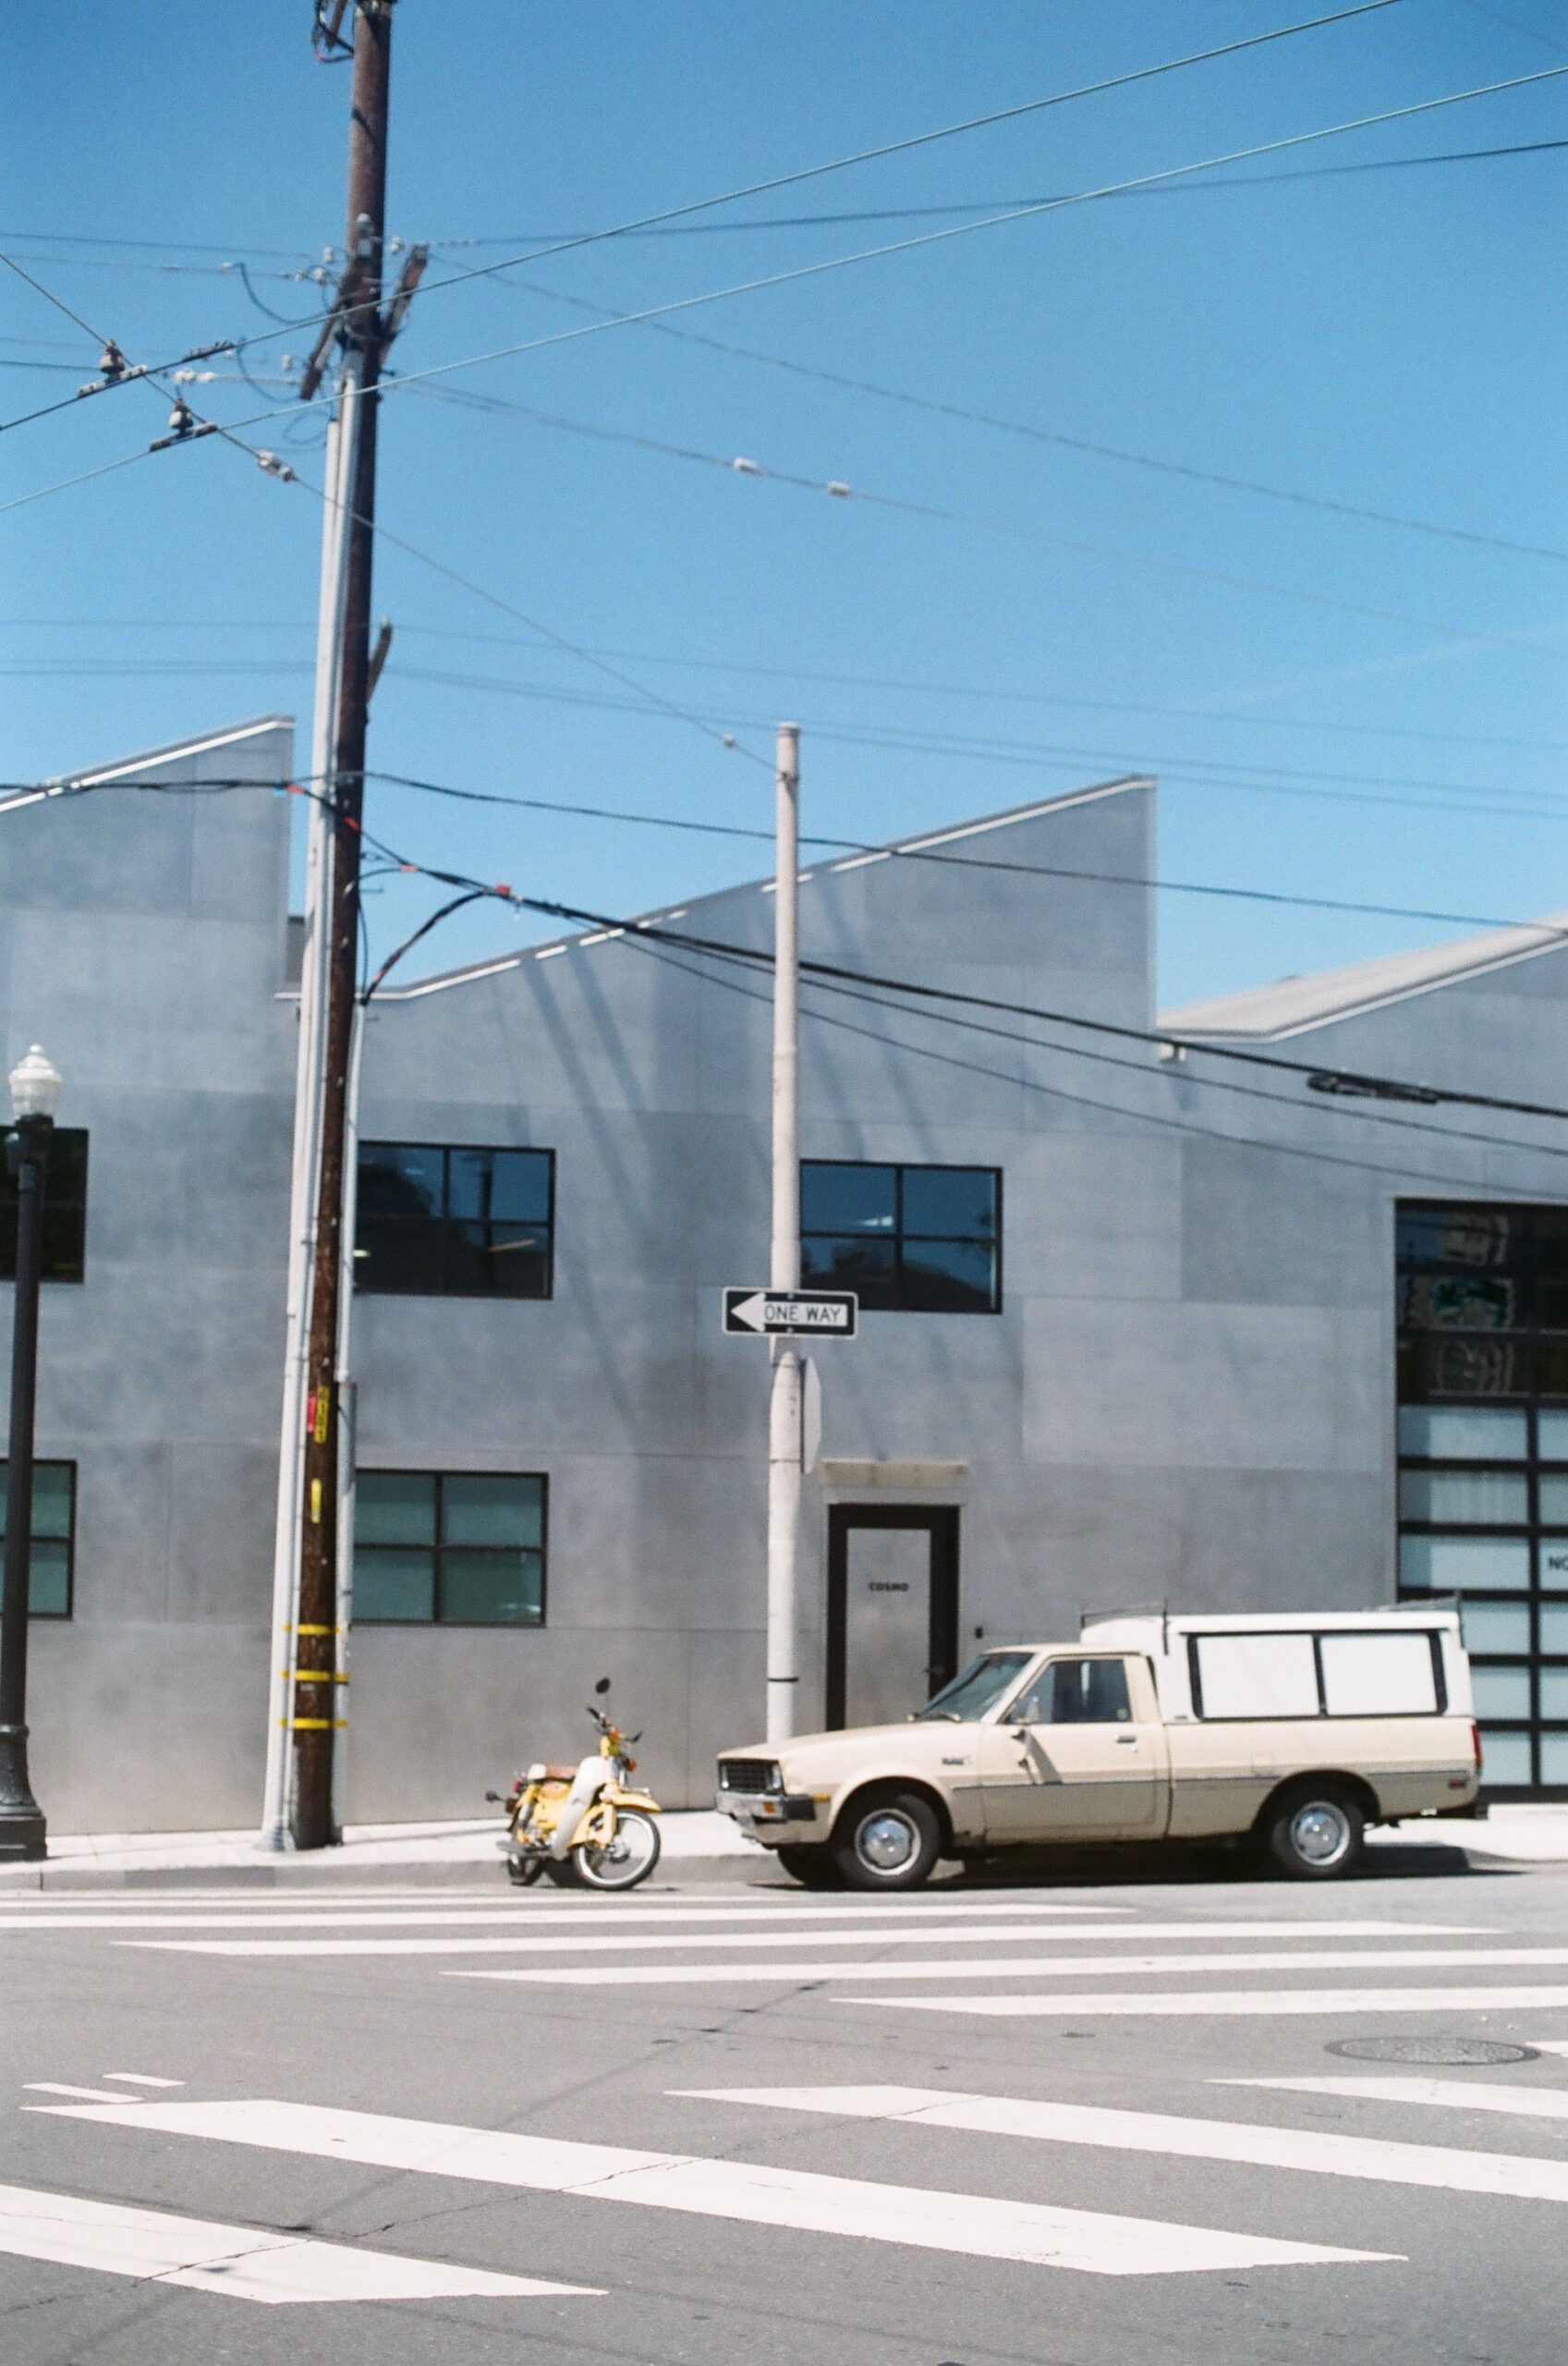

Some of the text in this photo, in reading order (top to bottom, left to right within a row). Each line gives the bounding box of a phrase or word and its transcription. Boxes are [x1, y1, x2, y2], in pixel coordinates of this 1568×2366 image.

[764, 1304, 841, 1322] ONE WAY
[869, 1581, 909, 1592] COSMO
